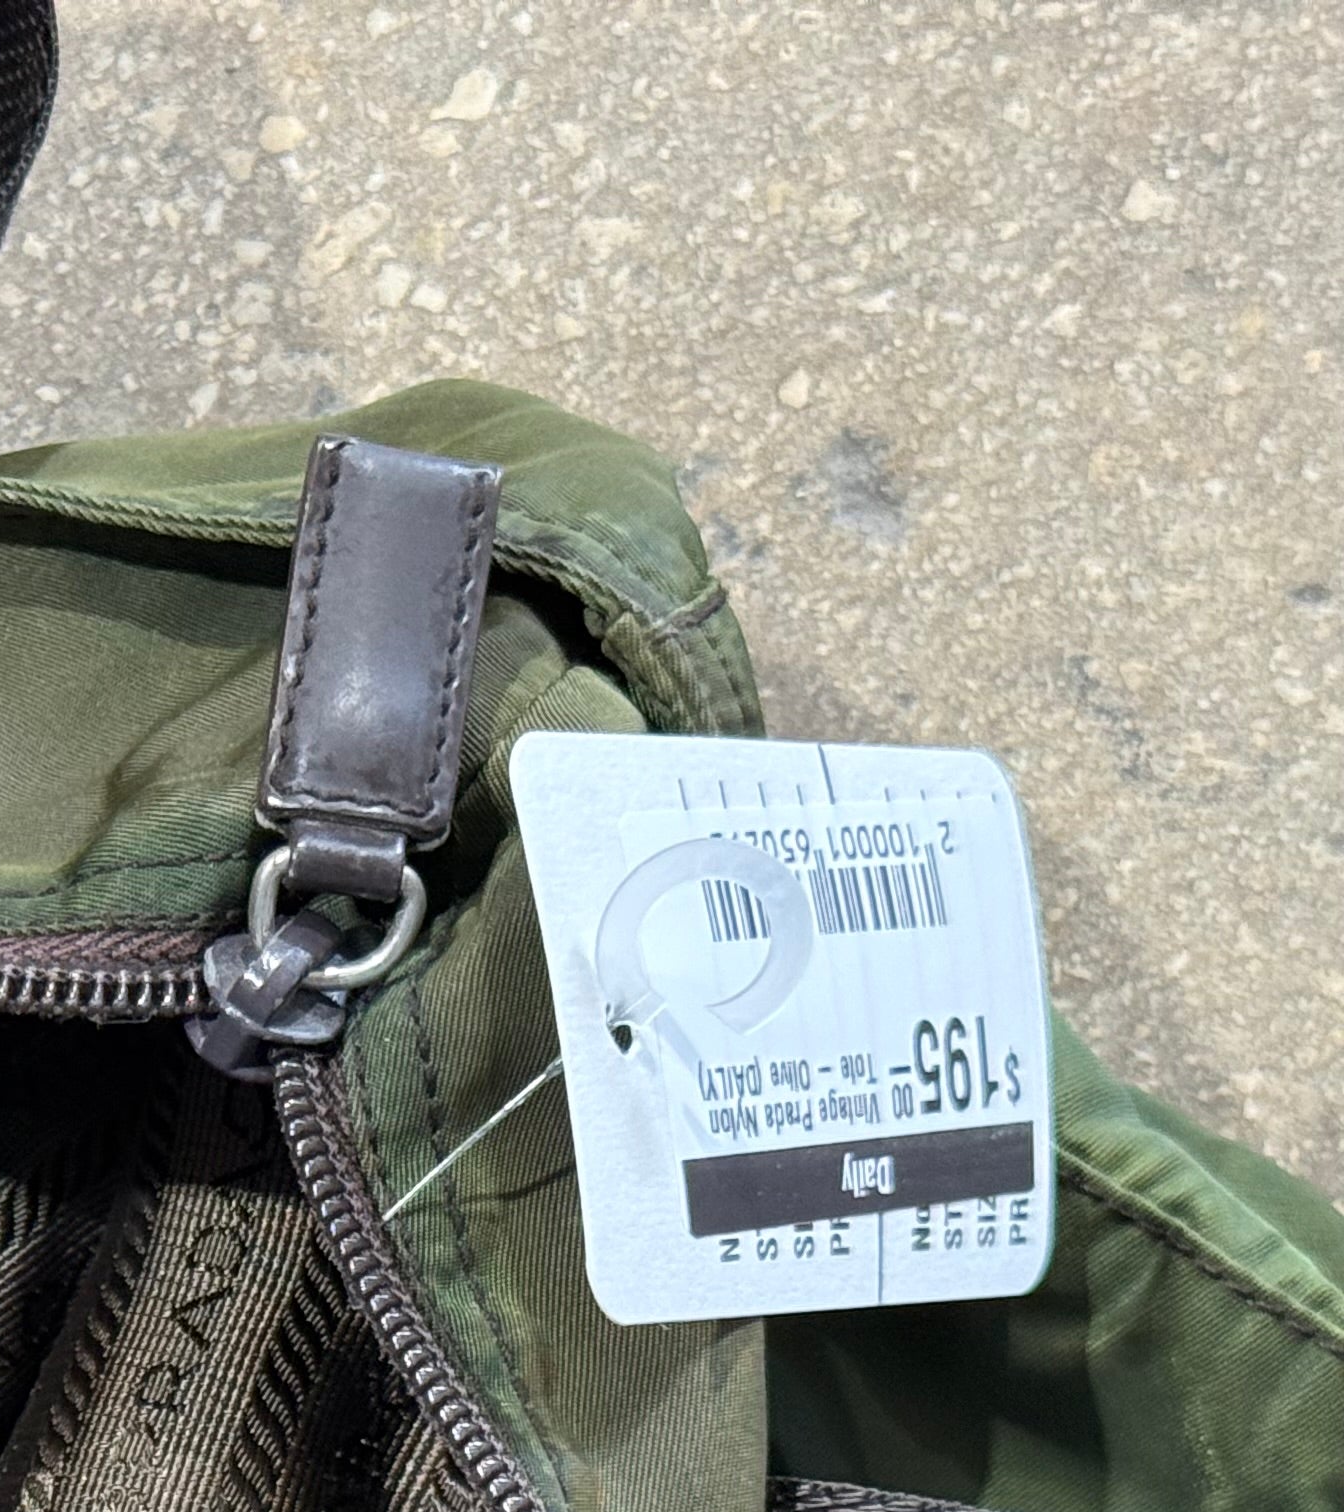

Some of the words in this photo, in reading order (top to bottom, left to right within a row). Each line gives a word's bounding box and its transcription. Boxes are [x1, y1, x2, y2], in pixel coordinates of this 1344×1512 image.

[710, 826, 812, 862] 650
[826, 822, 921, 860] 100001
[936, 819, 956, 855] 2
[698, 1055, 762, 1102] (DAILY)
[770, 1058, 811, 1092] Olive
[840, 1052, 878, 1085] Tote
[708, 1097, 759, 1140] Nylon
[764, 1099, 814, 1135] Prada
[819, 1089, 881, 1125] Vintage
[840, 1152, 897, 1199] Daily
